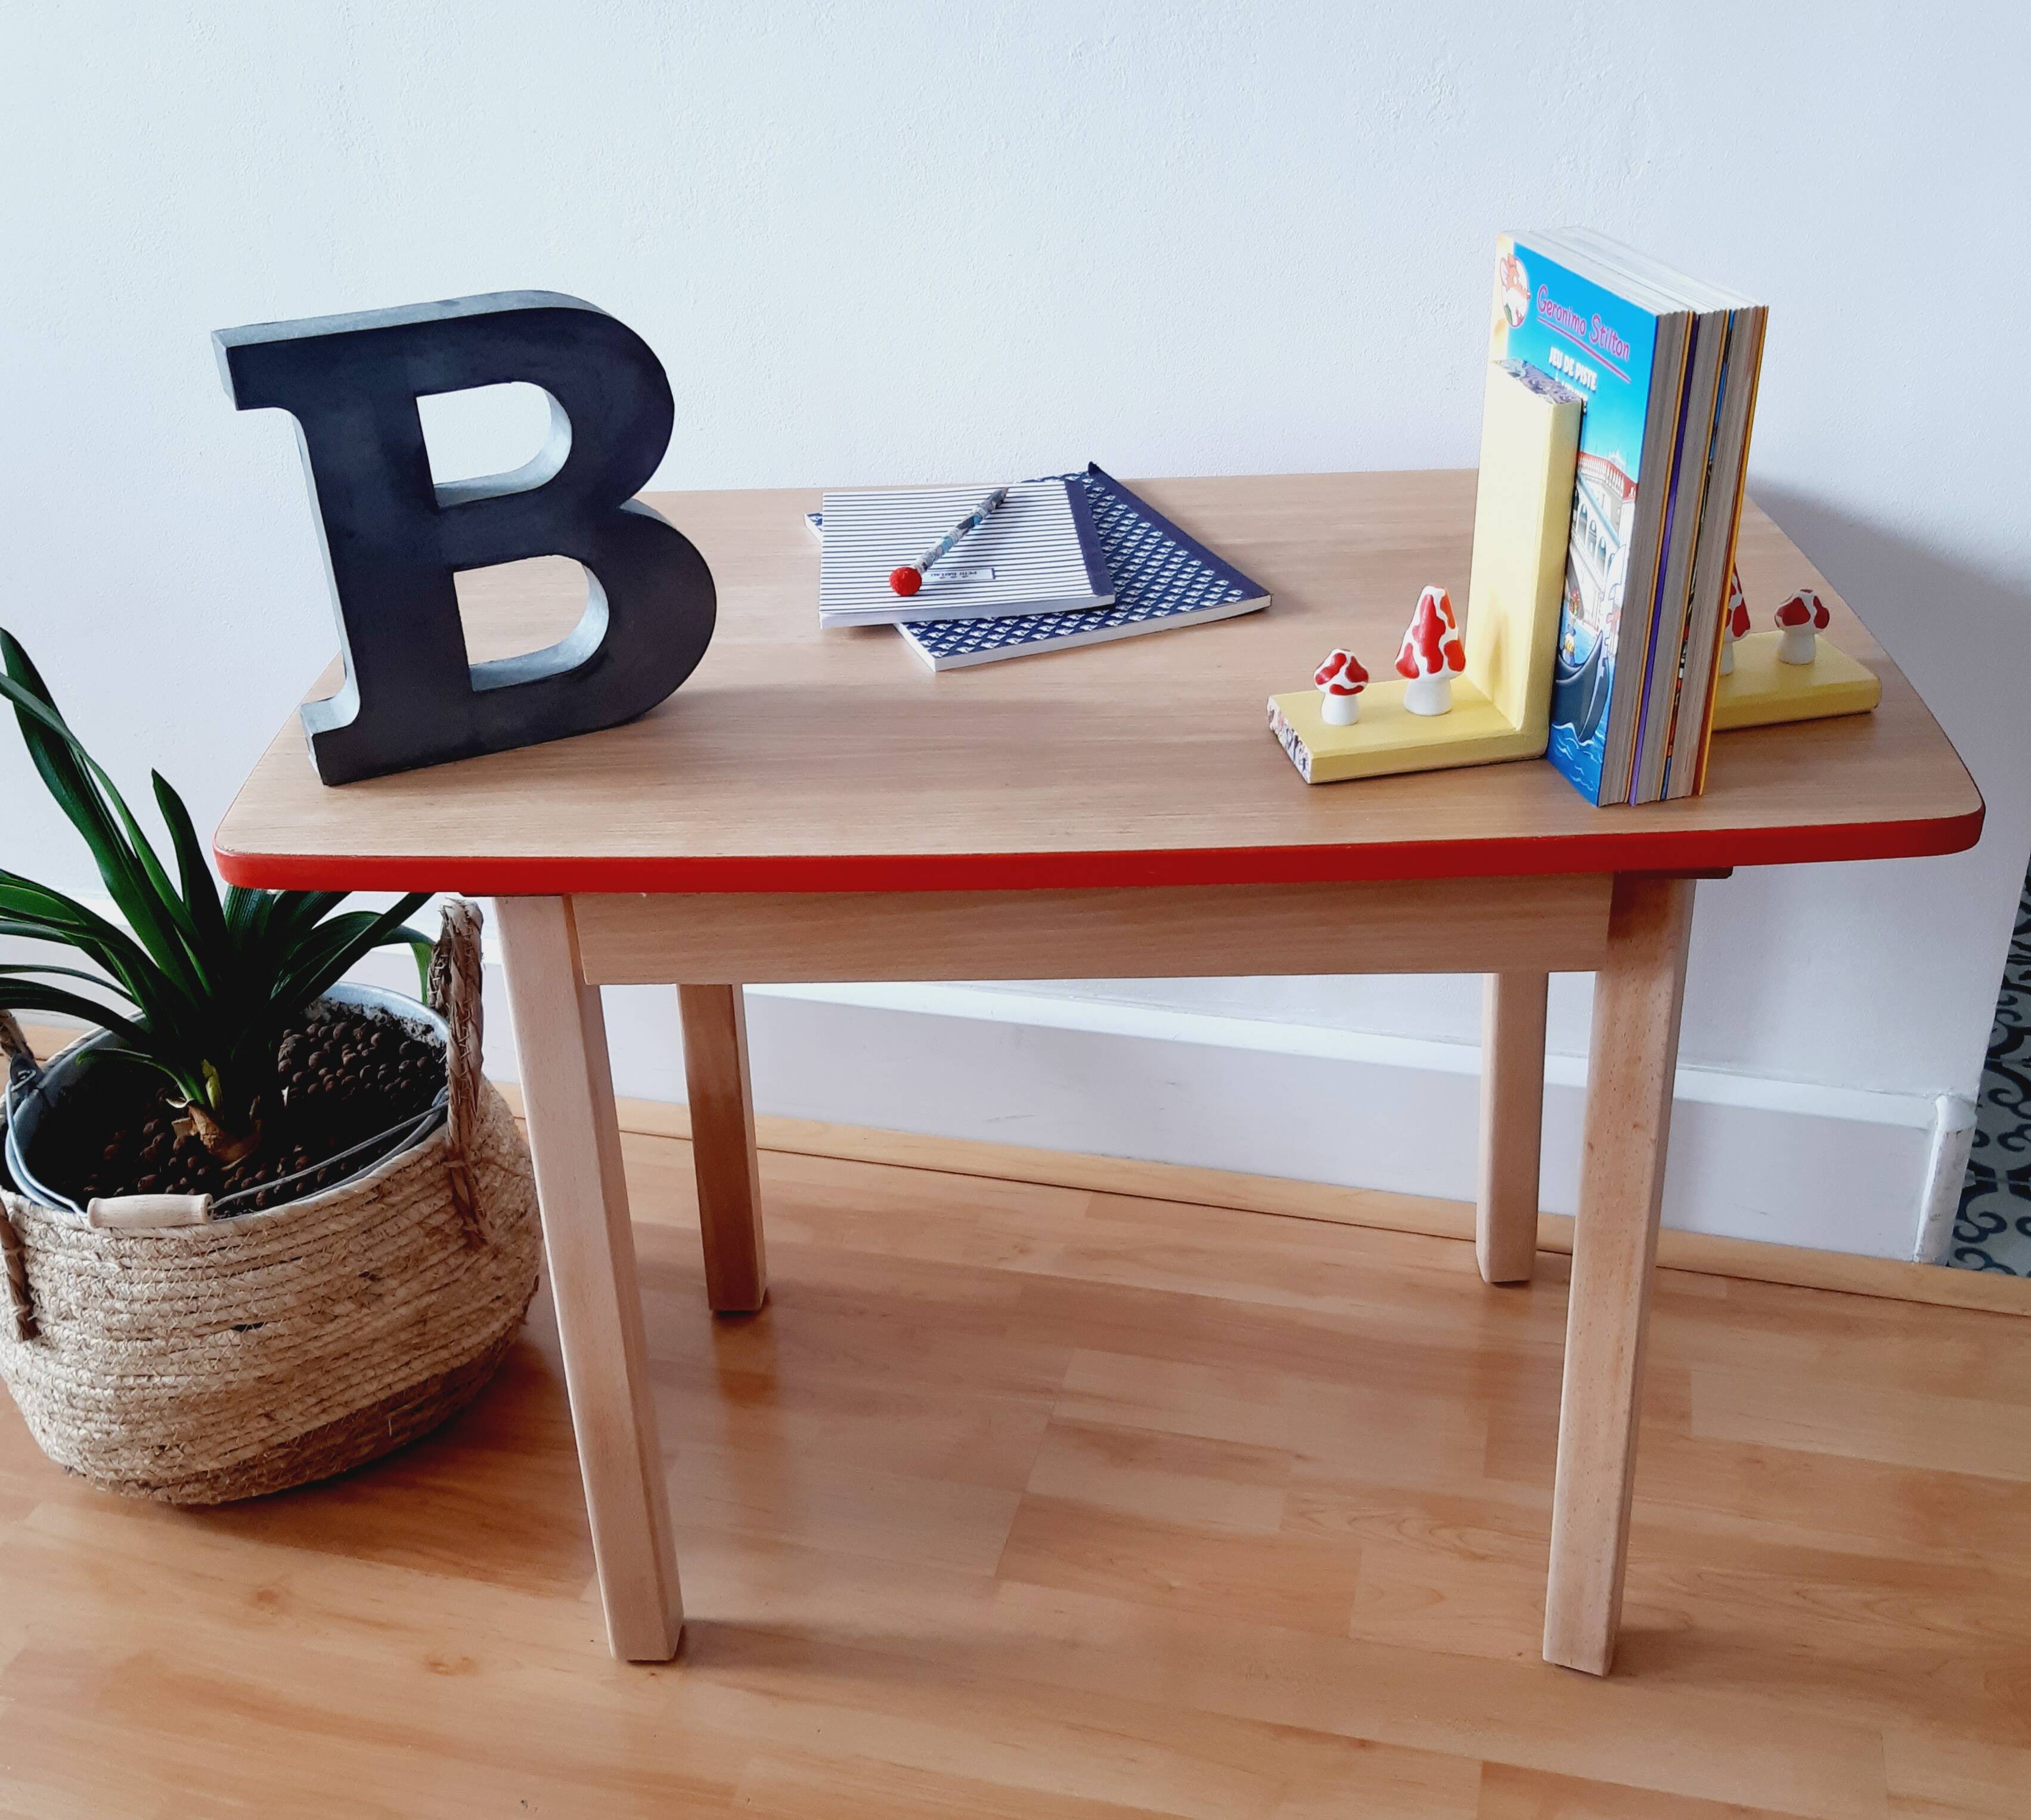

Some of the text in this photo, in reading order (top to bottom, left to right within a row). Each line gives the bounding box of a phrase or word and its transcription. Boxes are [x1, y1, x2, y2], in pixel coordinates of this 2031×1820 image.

[1537, 284, 1629, 362] Geronimo Stilton
[1549, 346, 1597, 392] JEU DE PISTE
[212, 290, 716, 786] B
